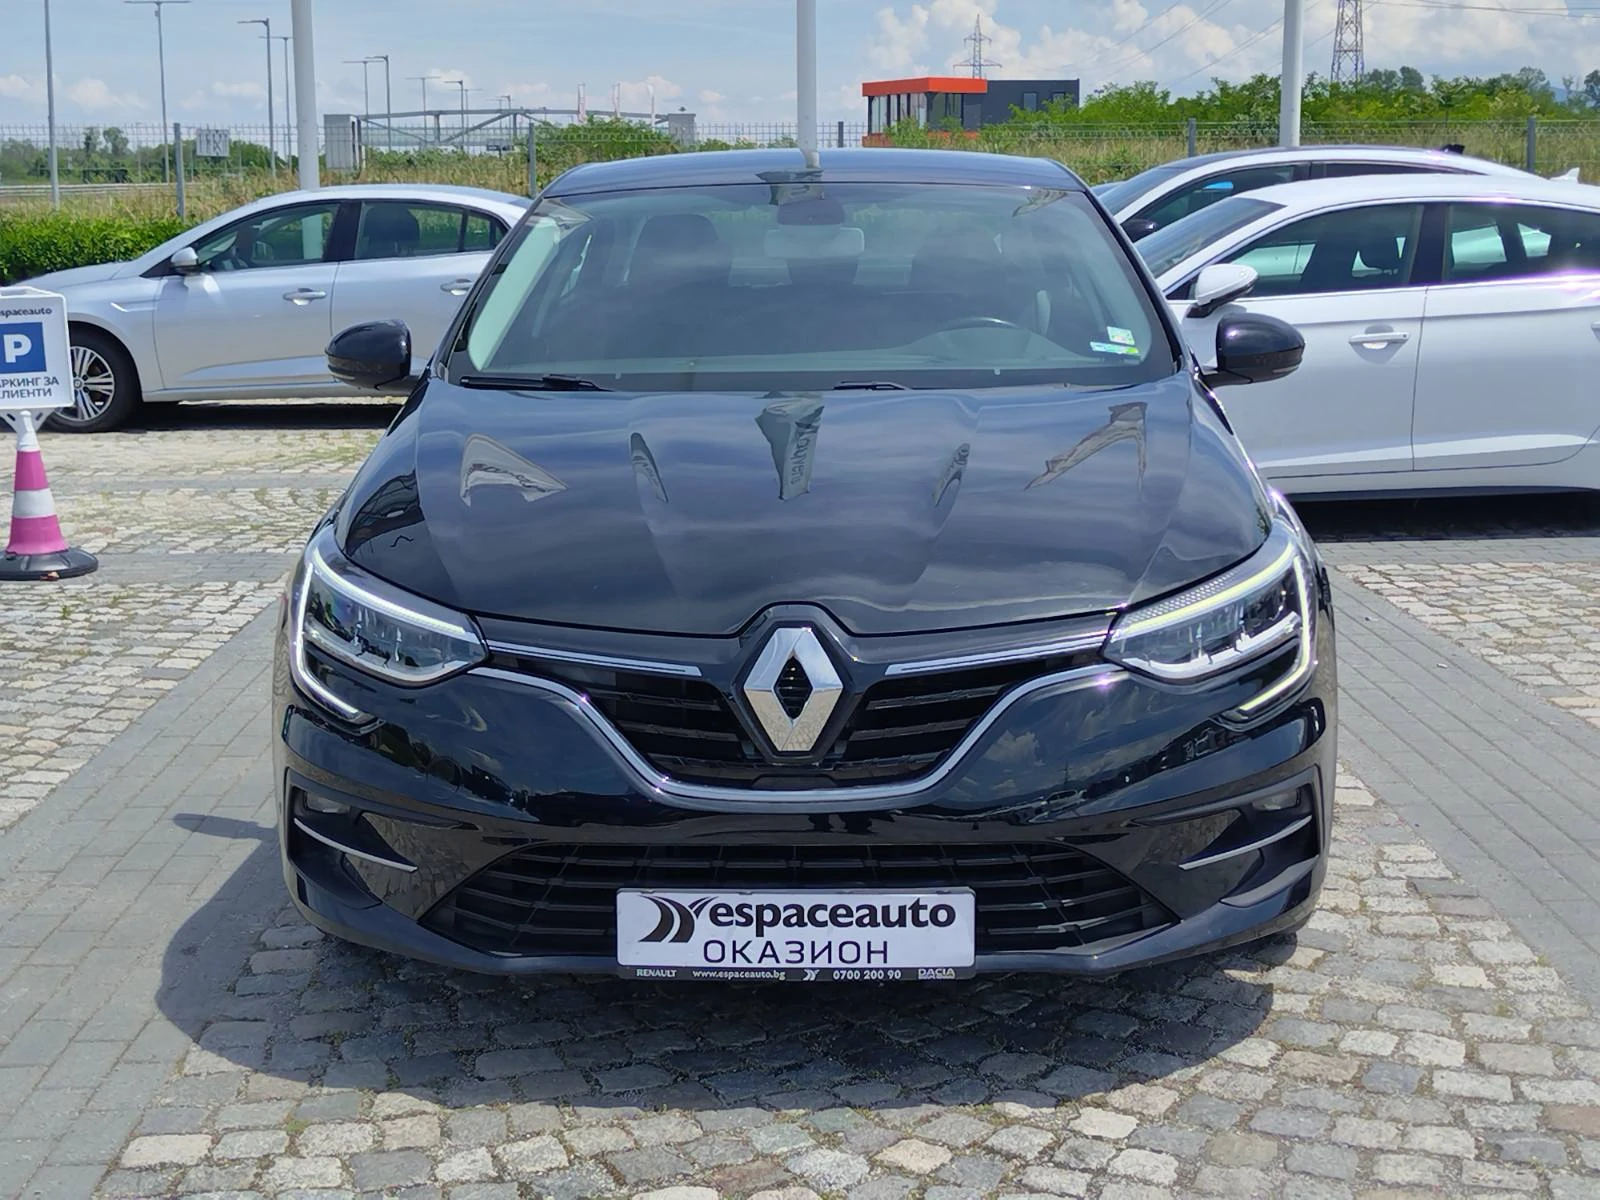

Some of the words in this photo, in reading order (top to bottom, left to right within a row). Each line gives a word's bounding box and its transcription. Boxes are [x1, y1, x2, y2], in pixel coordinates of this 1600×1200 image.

[0, 308, 52, 318] spaceauto
[3, 334, 32, 363] P
[0, 377, 42, 388] РКИНГ
[43, 376, 59, 386] ЗА
[0, 388, 52, 399] ЛИЕНТИ
[708, 897, 957, 938] espaceauto
[703, 939, 889, 964] ОКАЗИОН
[636, 969, 678, 978] RENAULT
[692, 969, 786, 981] www.espaceauto.bg
[832, 969, 861, 980] 0700
[863, 969, 885, 980] 200
[887, 969, 902, 980] 90
[918, 968, 956, 979] DACIA
